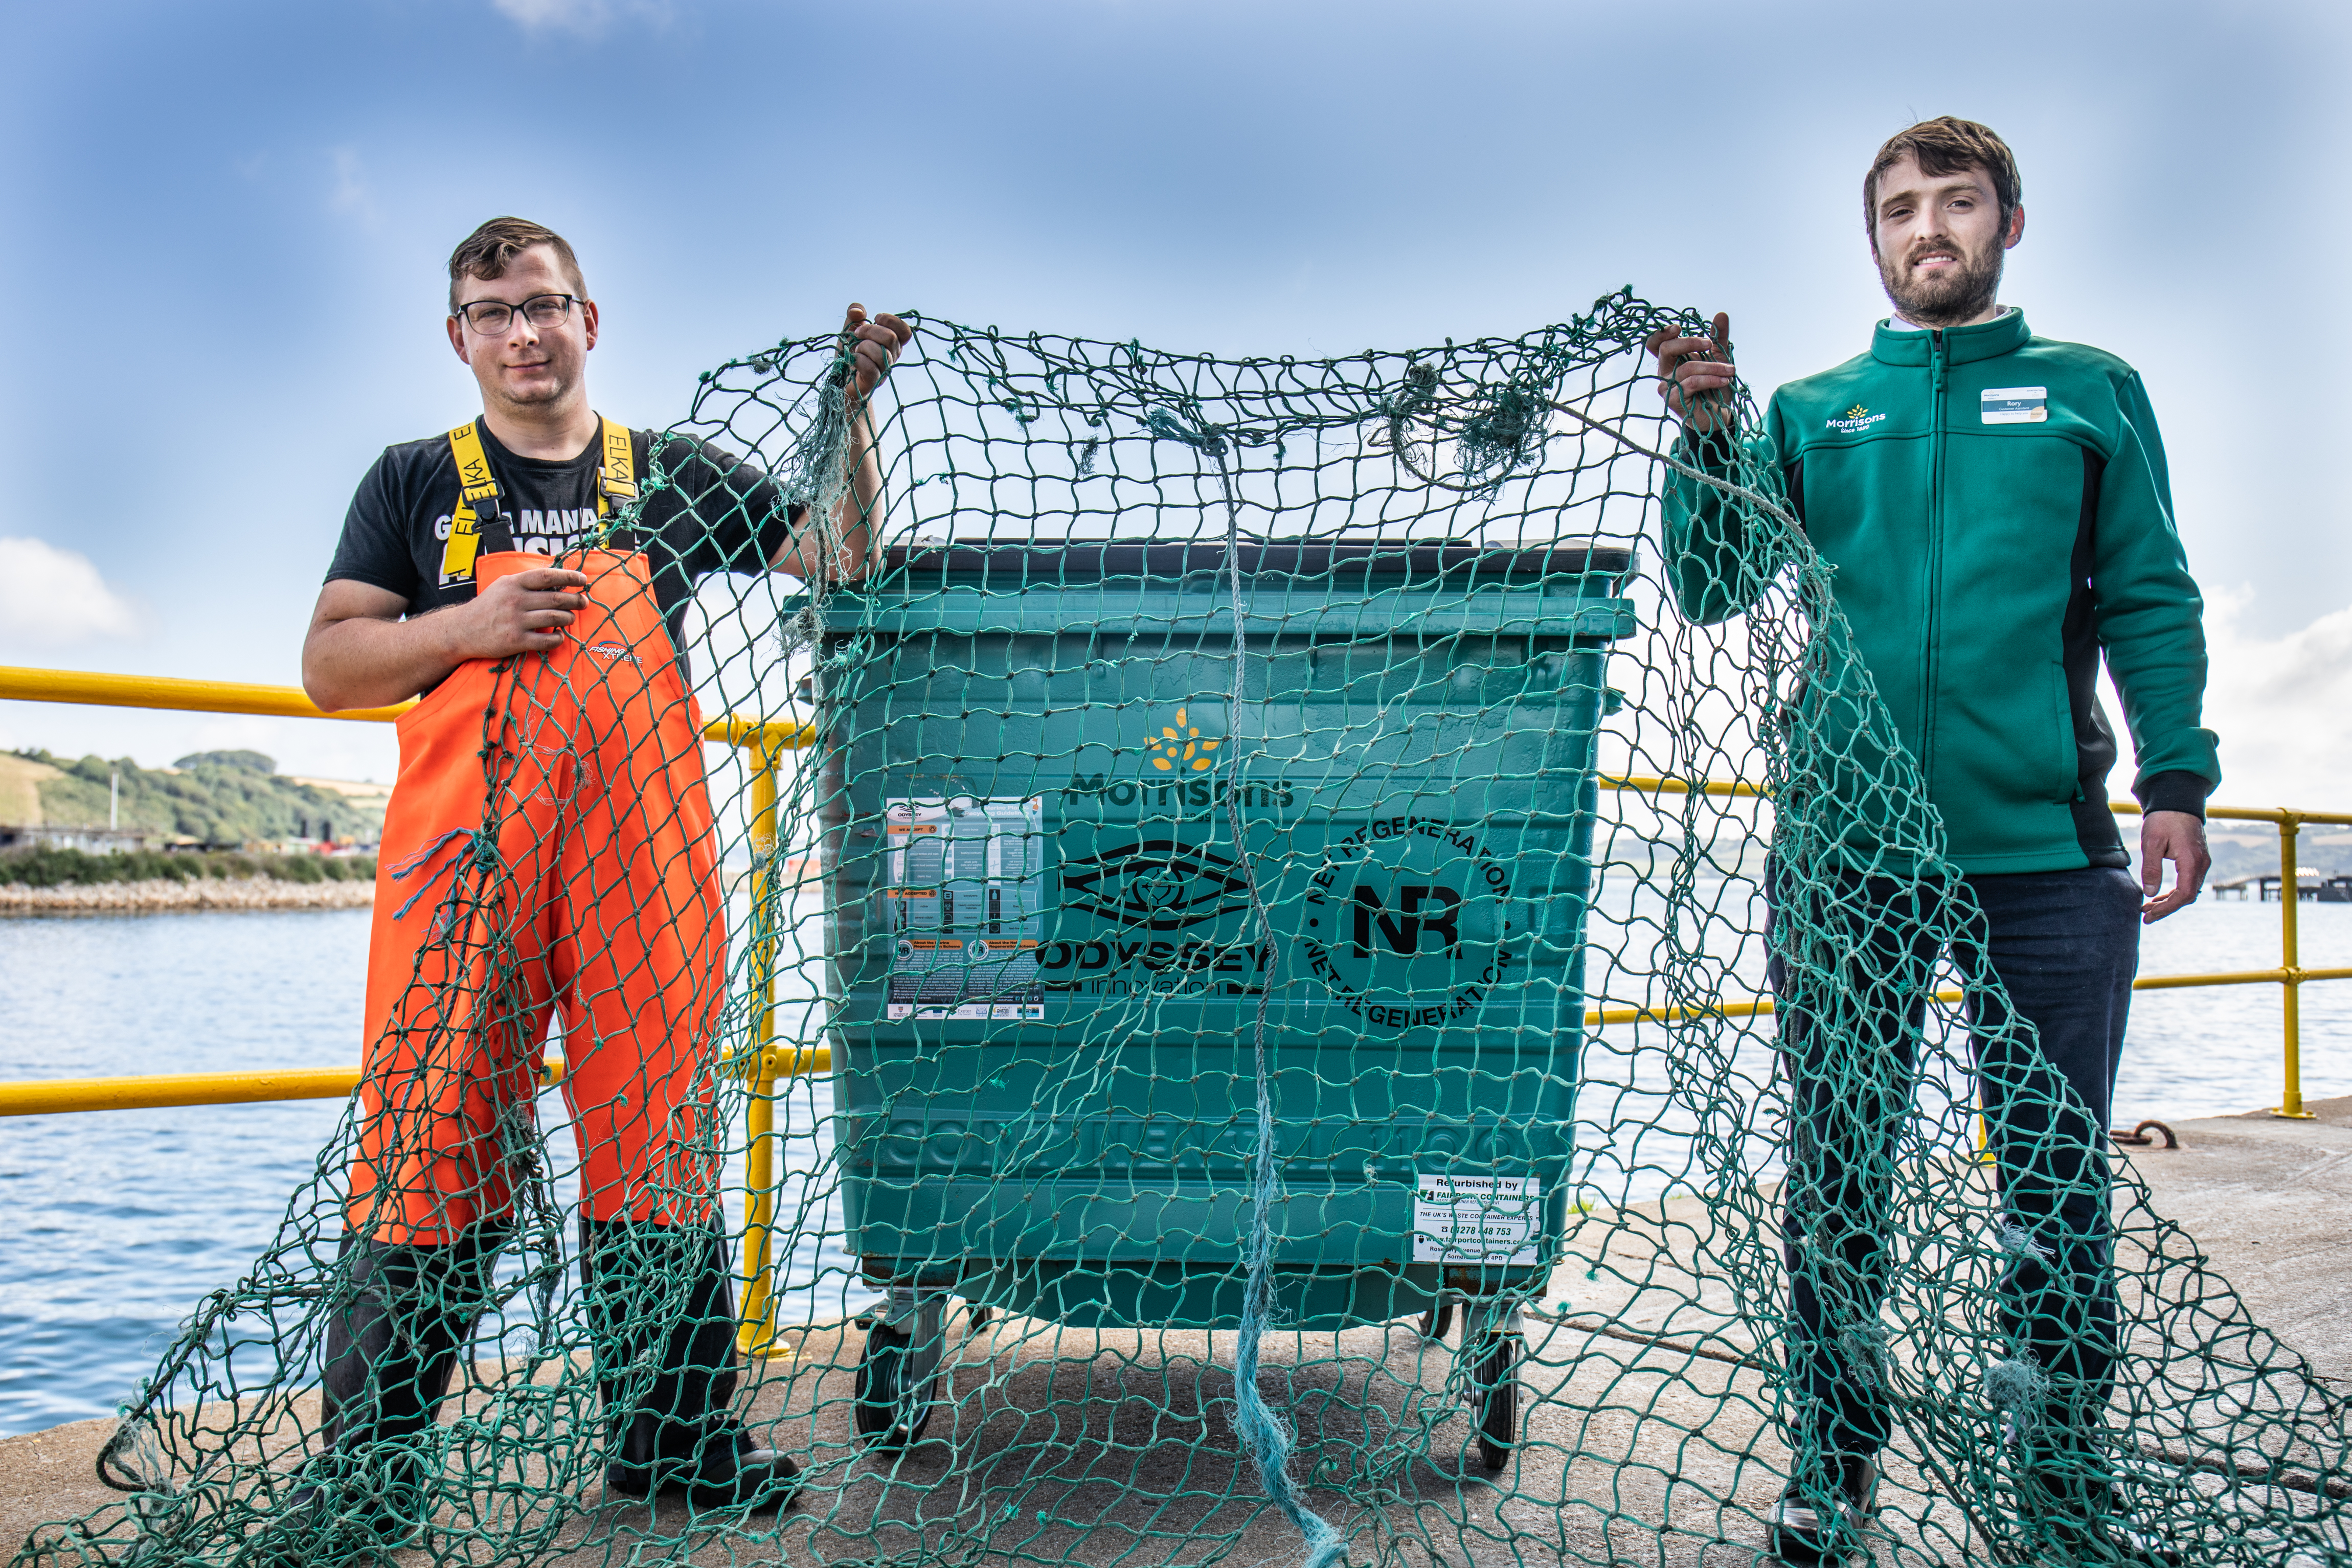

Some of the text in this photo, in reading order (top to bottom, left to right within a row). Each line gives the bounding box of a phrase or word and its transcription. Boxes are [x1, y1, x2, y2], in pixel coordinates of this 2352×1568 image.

[1826, 413, 1886, 428] Morrisons
[609, 435, 629, 480] ELKA
[589, 646, 625, 654] FISHING
[1069, 766, 1294, 808] Morrisons
[1353, 885, 1463, 960] NR
[1035, 941, 1271, 972] ODYSSEY
[1092, 976, 1220, 995] innovation
[1304, 939, 1512, 1028] NET REGENERATION
[1436, 1179, 1518, 1191] Refurbished by
[1496, 1228, 1511, 1236] 753
